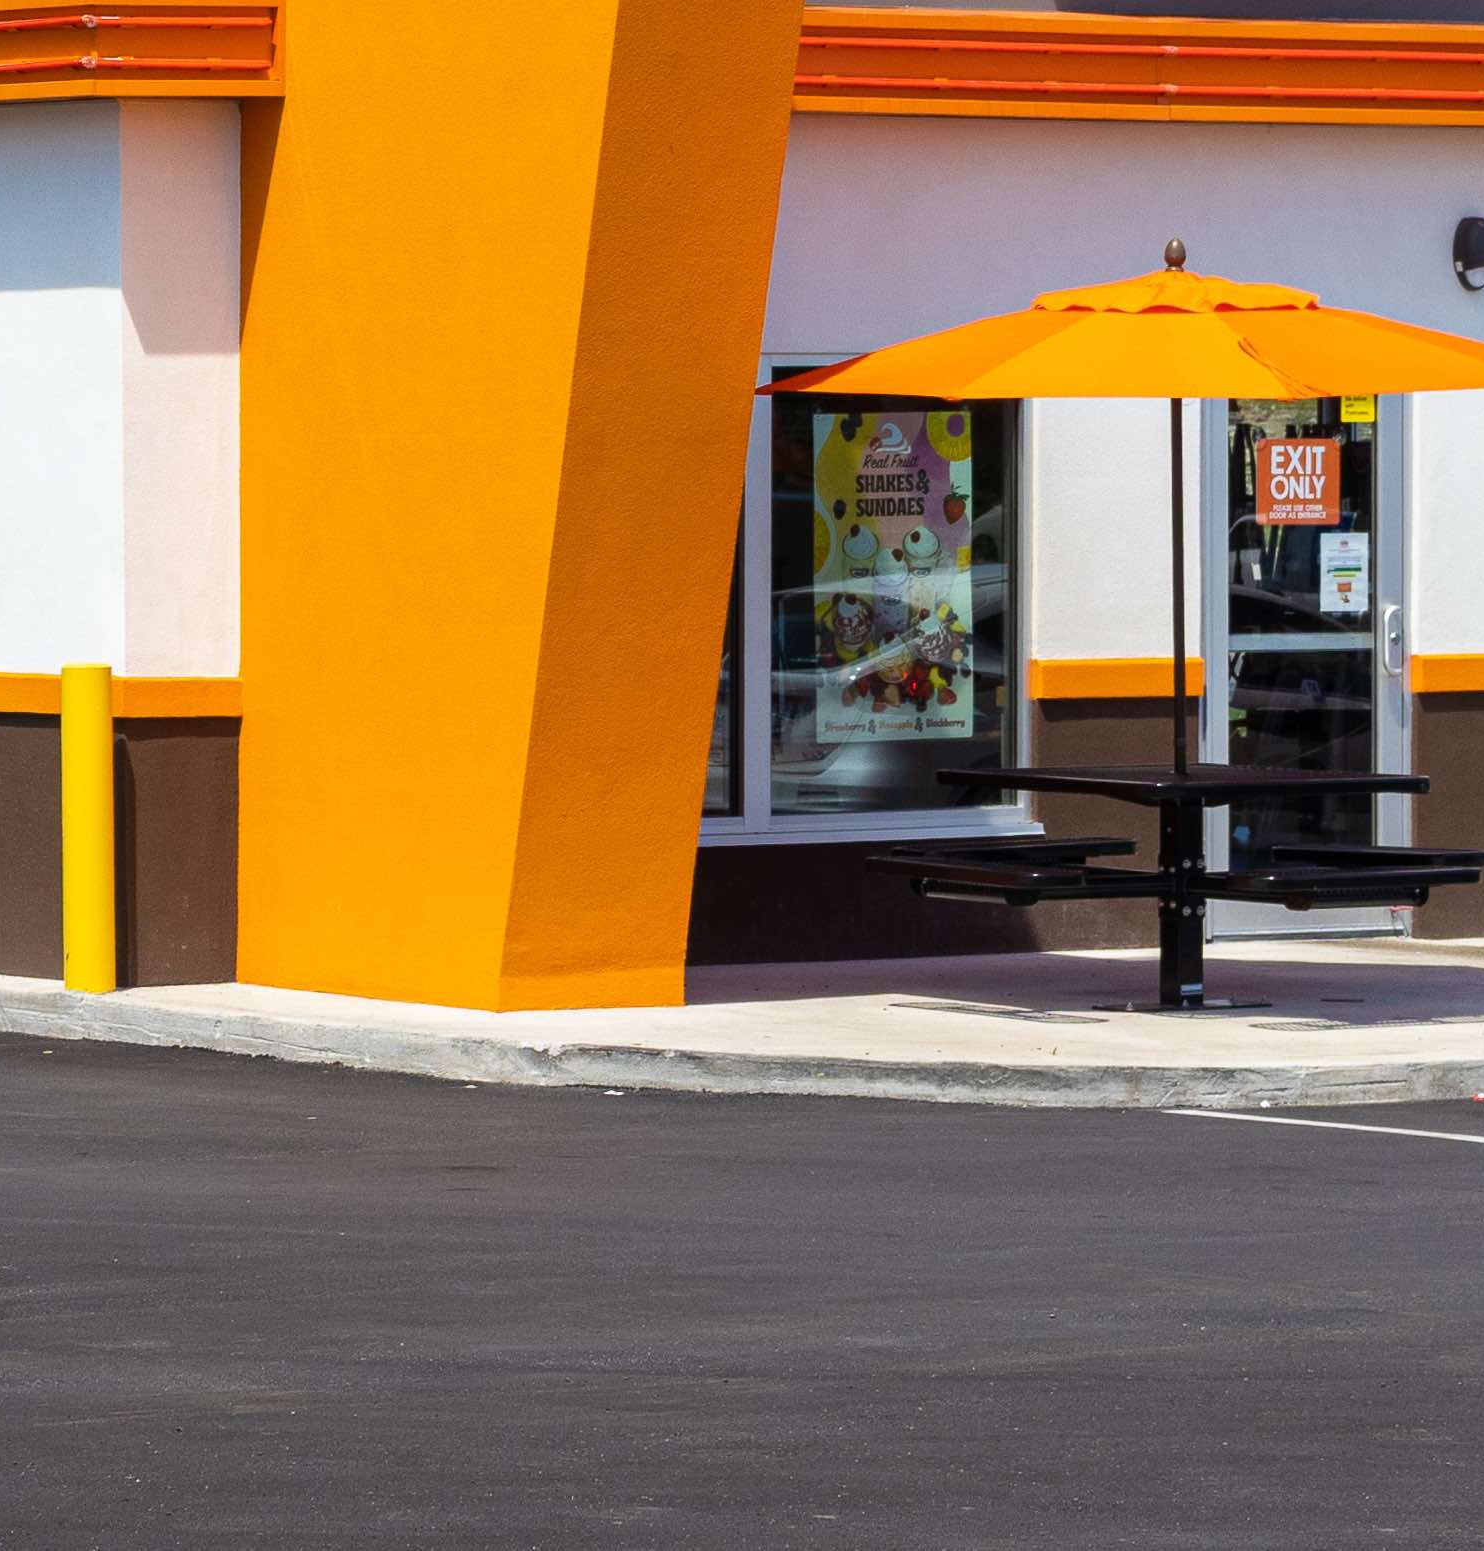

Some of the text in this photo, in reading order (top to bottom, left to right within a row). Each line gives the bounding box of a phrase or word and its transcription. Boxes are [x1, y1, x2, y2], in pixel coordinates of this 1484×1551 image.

[863, 455, 919, 469] Real Fruit
[1270, 445, 1326, 475] EXIT
[855, 469, 930, 495] SHAKES &
[1270, 475, 1326, 500] ONLY
[856, 497, 925, 517] SUNDAES
